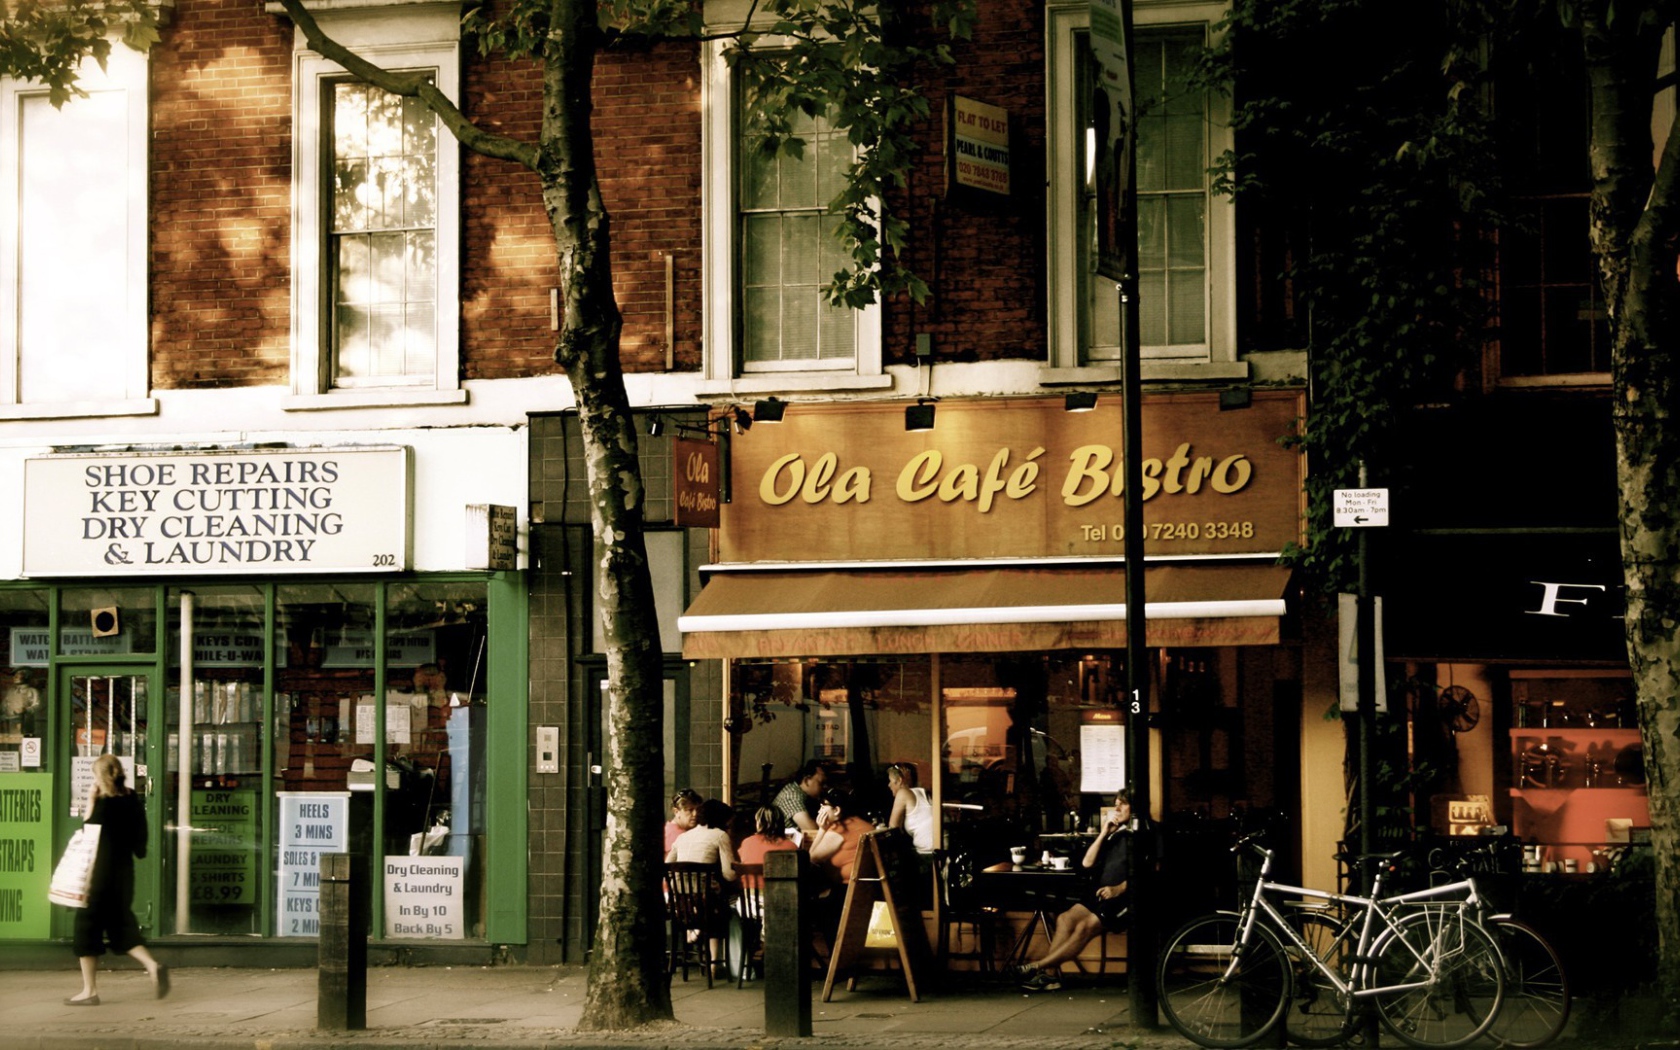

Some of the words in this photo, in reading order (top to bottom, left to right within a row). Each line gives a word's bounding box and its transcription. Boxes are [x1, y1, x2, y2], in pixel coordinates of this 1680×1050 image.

[958, 110, 976, 126] FLAT
[978, 116, 990, 129] TO
[991, 120, 1006, 134] LET
[956, 139, 976, 157] PEARL
[978, 145, 983, 158] &
[984, 147, 1008, 164] COUTTS
[959, 162, 971, 174] 020
[85, 464, 176, 487] SHOE
[190, 461, 339, 485] REPAIRS
[686, 452, 709, 483] Ola
[759, 452, 871, 505] Ola
[896, 446, 1046, 512] Café
[1061, 442, 1252, 506] Bistro
[90, 490, 160, 513] KEY
[173, 487, 332, 511] CUTTING
[697, 492, 716, 511] Bistro
[81, 516, 149, 539] DRY
[160, 513, 343, 538] CLEANING
[1081, 524, 1106, 540] Tel
[1152, 523, 1199, 540] 7240
[1205, 521, 1254, 538] 3348
[104, 542, 134, 565] &
[144, 539, 316, 564] LAUNDRY
[372, 554, 396, 567] 202
[1524, 580, 1625, 618] F
[19, 634, 50, 645] WATC
[197, 636, 229, 646] KEYS
[234, 636, 259, 646] CUT
[206, 794, 231, 802] DRY
[192, 806, 249, 815] LEANING
[300, 804, 329, 818] HEELS
[295, 825, 301, 838] 3
[306, 825, 332, 839] MINS
[192, 835, 243, 844] REPAIRS
[0, 839, 34, 872] TRAPS
[284, 852, 308, 865] SOLES
[311, 852, 316, 865] &
[202, 873, 245, 882] SHIRTS
[387, 864, 407, 877] Dry
[410, 865, 459, 878] Cleaning
[294, 872, 300, 886] 7
[303, 872, 320, 887] MIN
[194, 886, 242, 900] £8.99
[394, 883, 402, 893] &
[405, 883, 452, 896] Laundry
[287, 898, 312, 912] KEYS
[400, 905, 410, 916] In
[413, 905, 428, 918] By
[433, 905, 447, 916] 10
[292, 919, 298, 932] 2
[302, 919, 320, 933] MIN
[394, 923, 423, 934] Back
[426, 923, 442, 936] By
[445, 924, 452, 934] 5
